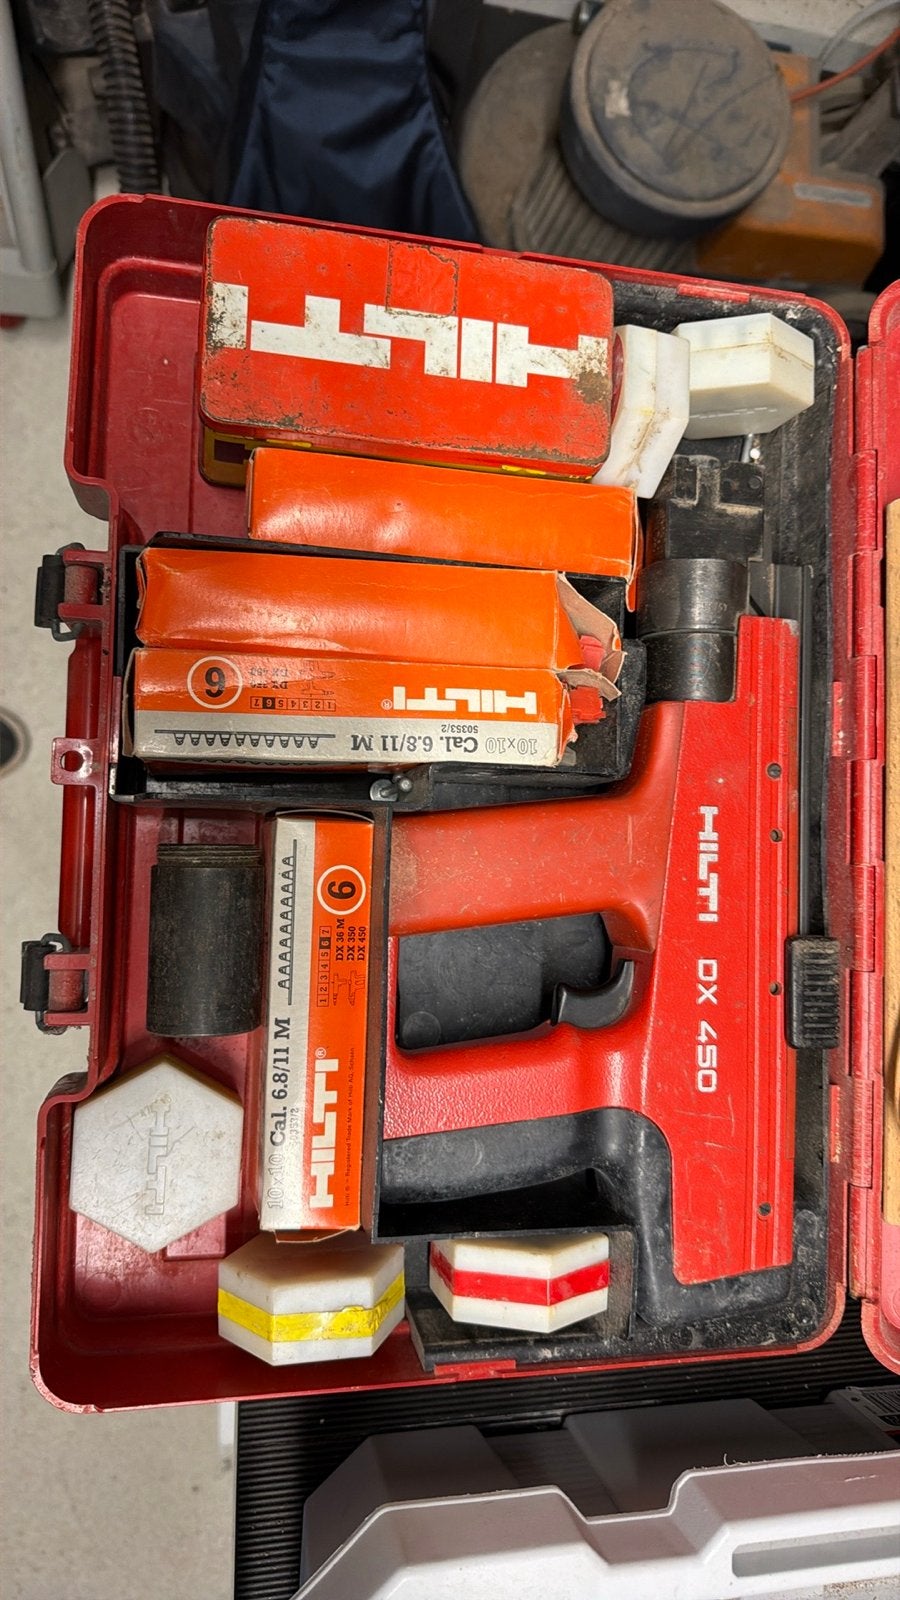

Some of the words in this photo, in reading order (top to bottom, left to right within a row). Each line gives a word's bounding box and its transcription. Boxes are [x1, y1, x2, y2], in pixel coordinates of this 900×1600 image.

[206, 281, 608, 388] HILTI
[205, 666, 225, 698] 6
[440, 723, 479, 734] 50353/2
[350, 734, 374, 752] M
[380, 733, 434, 754] 6.8/11
[439, 736, 479, 754] Cal.
[485, 736, 538, 756] 10x10
[697, 805, 719, 922] HILTI
[327, 880, 357, 900] 6
[336, 918, 345, 929] M
[336, 931, 345, 943] 36
[347, 926, 357, 943] 350
[357, 926, 367, 943] 450
[336, 946, 345, 961] DX
[347, 946, 355, 961] DX
[357, 946, 366, 961] DX
[696, 958, 718, 1005] DX
[274, 1017, 291, 1040] M
[696, 1020, 718, 1093] 450
[272, 1046, 291, 1100] 6.8/11
[269, 1106, 288, 1147] Cal.
[145, 1094, 171, 1215] HILTI
